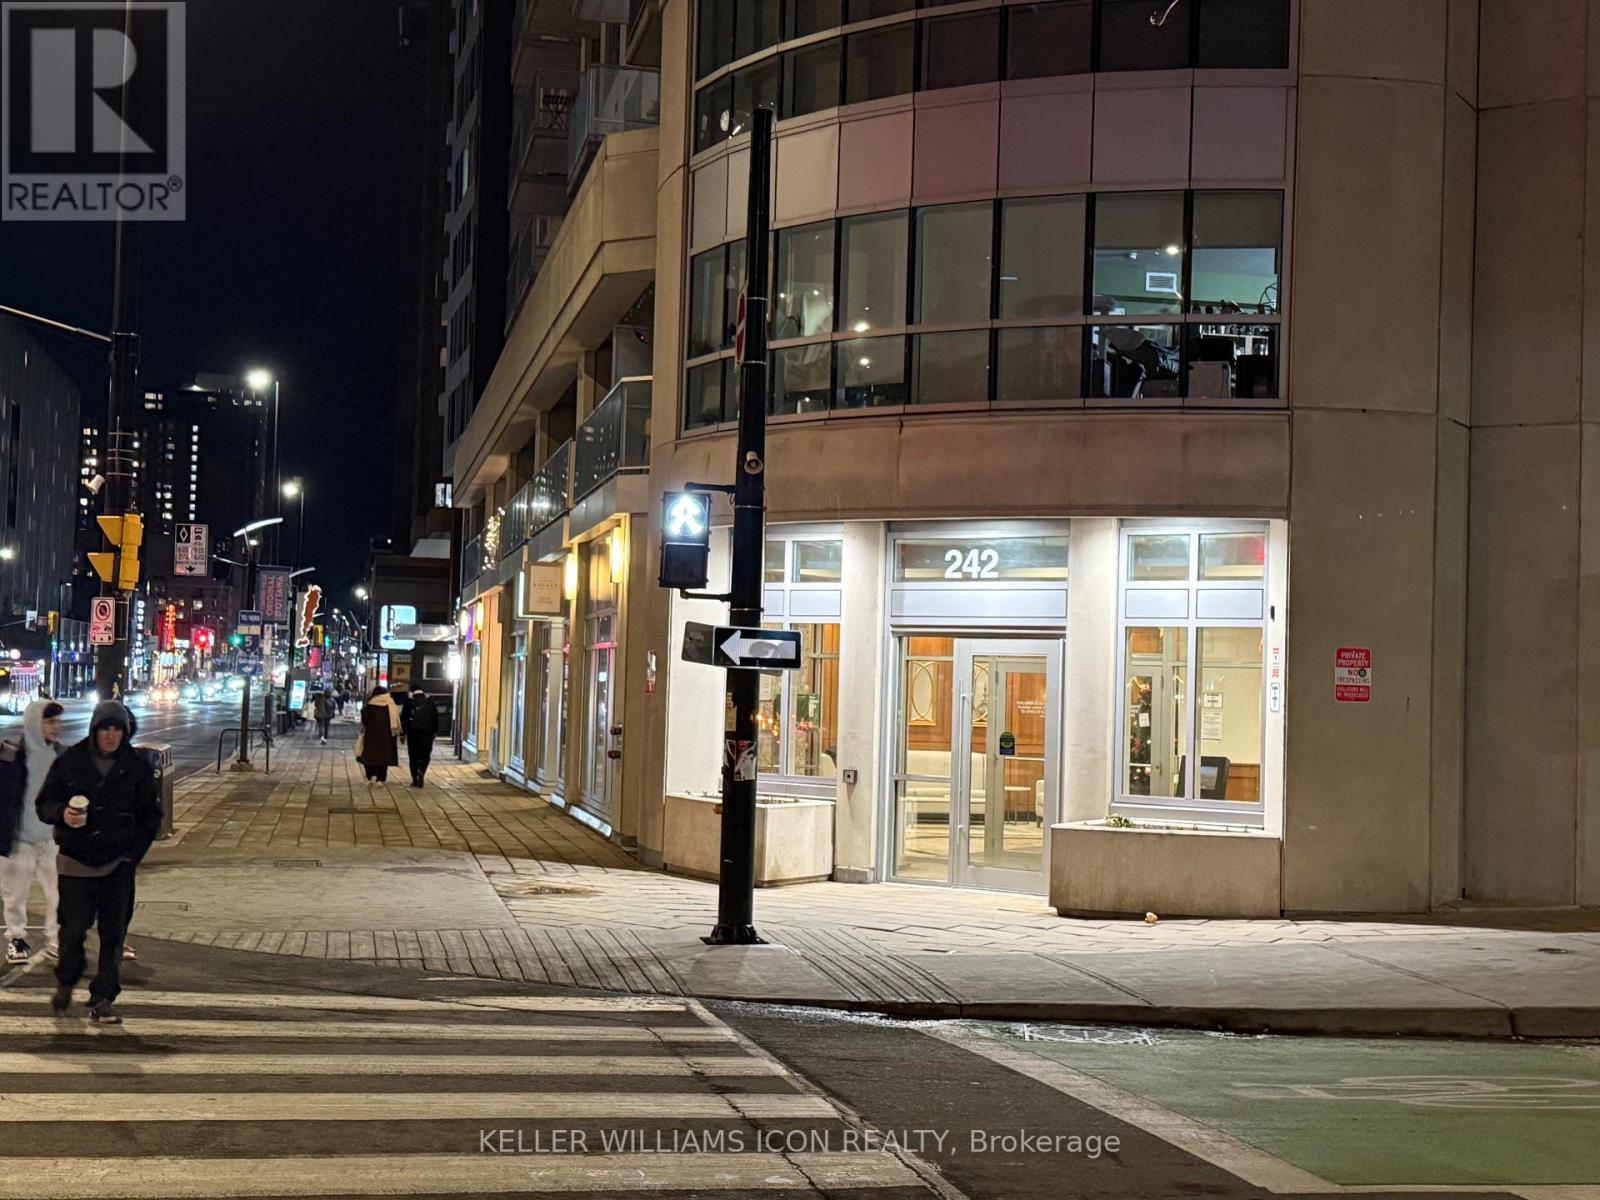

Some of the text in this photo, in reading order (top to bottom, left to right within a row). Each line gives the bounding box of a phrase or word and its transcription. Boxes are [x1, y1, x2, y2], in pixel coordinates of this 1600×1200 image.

[944, 549, 999, 578] 242
[244, 635, 253, 648] 5
[1341, 651, 1366, 659] PRIVATE
[1337, 659, 1369, 667] PROPERTY
